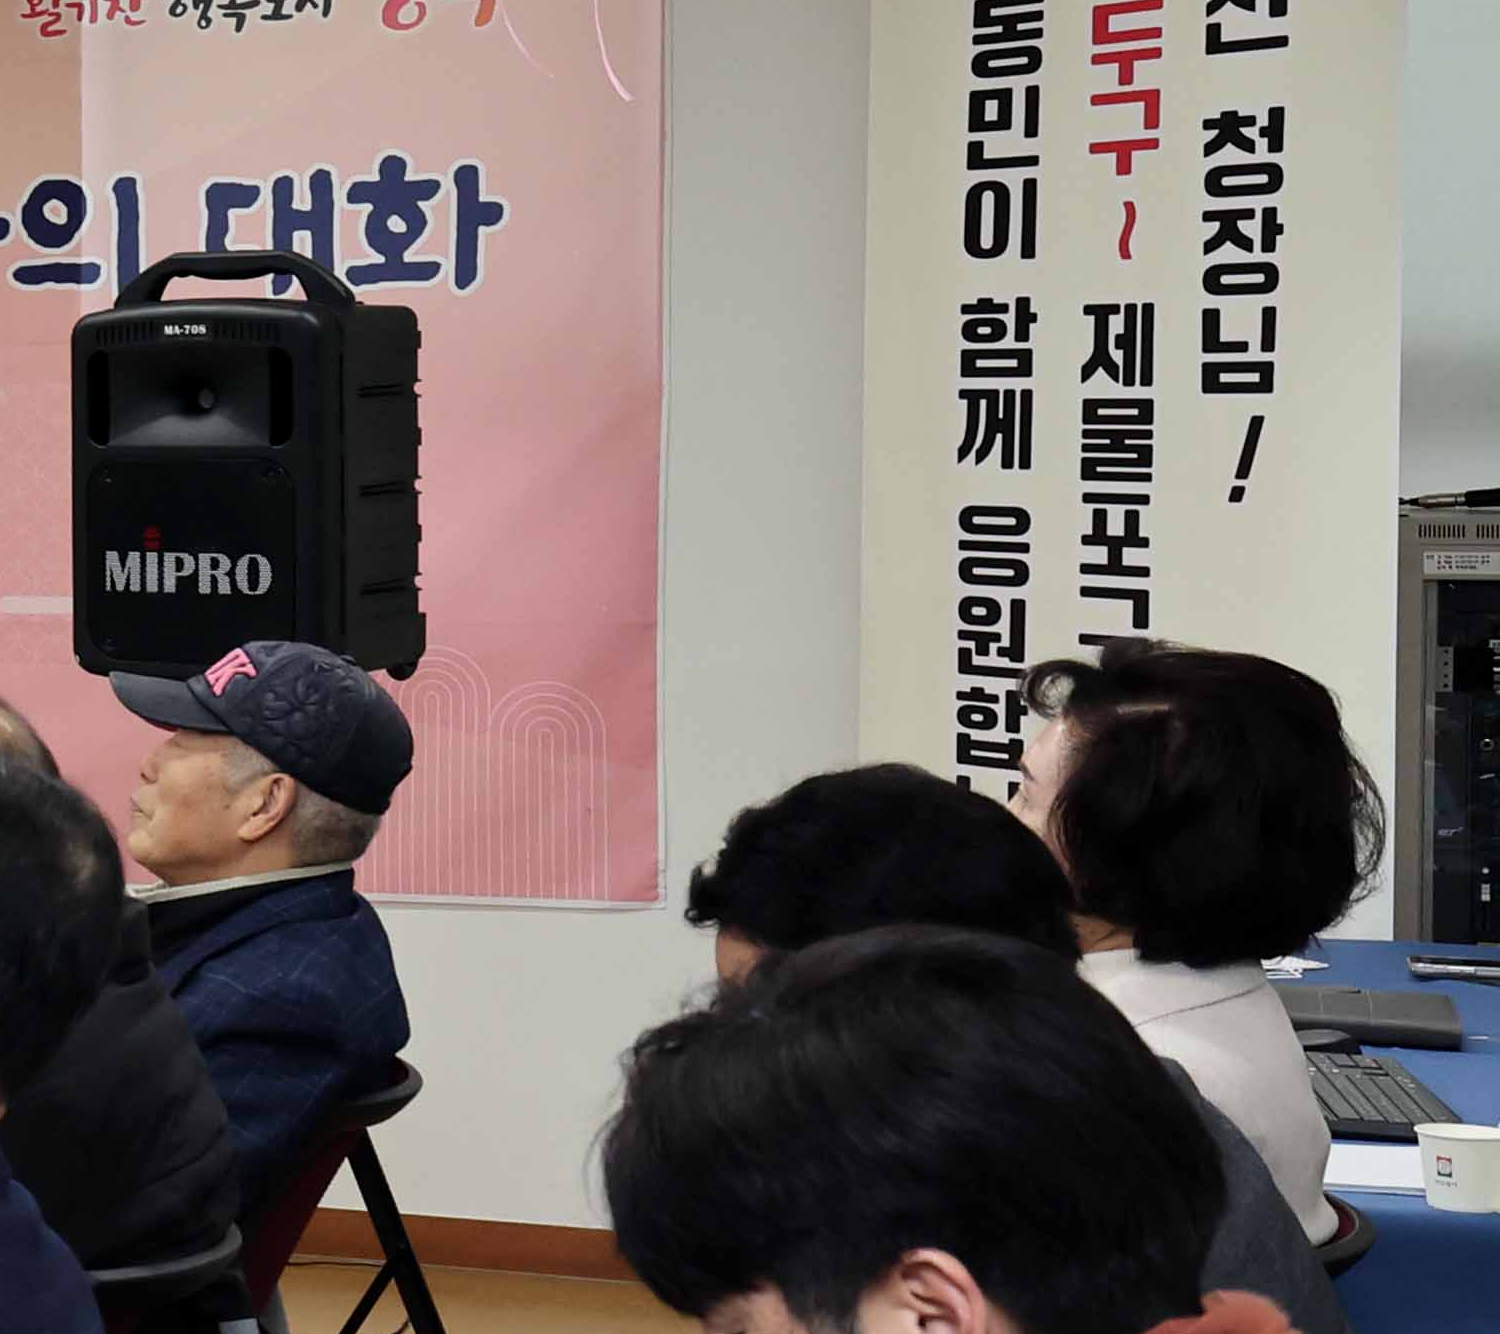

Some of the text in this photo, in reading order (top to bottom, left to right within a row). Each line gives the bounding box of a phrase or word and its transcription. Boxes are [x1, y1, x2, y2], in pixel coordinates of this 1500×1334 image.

[205, 154, 505, 296] 대화
[956, 296, 1038, 470] 함께
[104, 526, 273, 595] MIPRO
[955, 504, 1032, 804] 응원합
